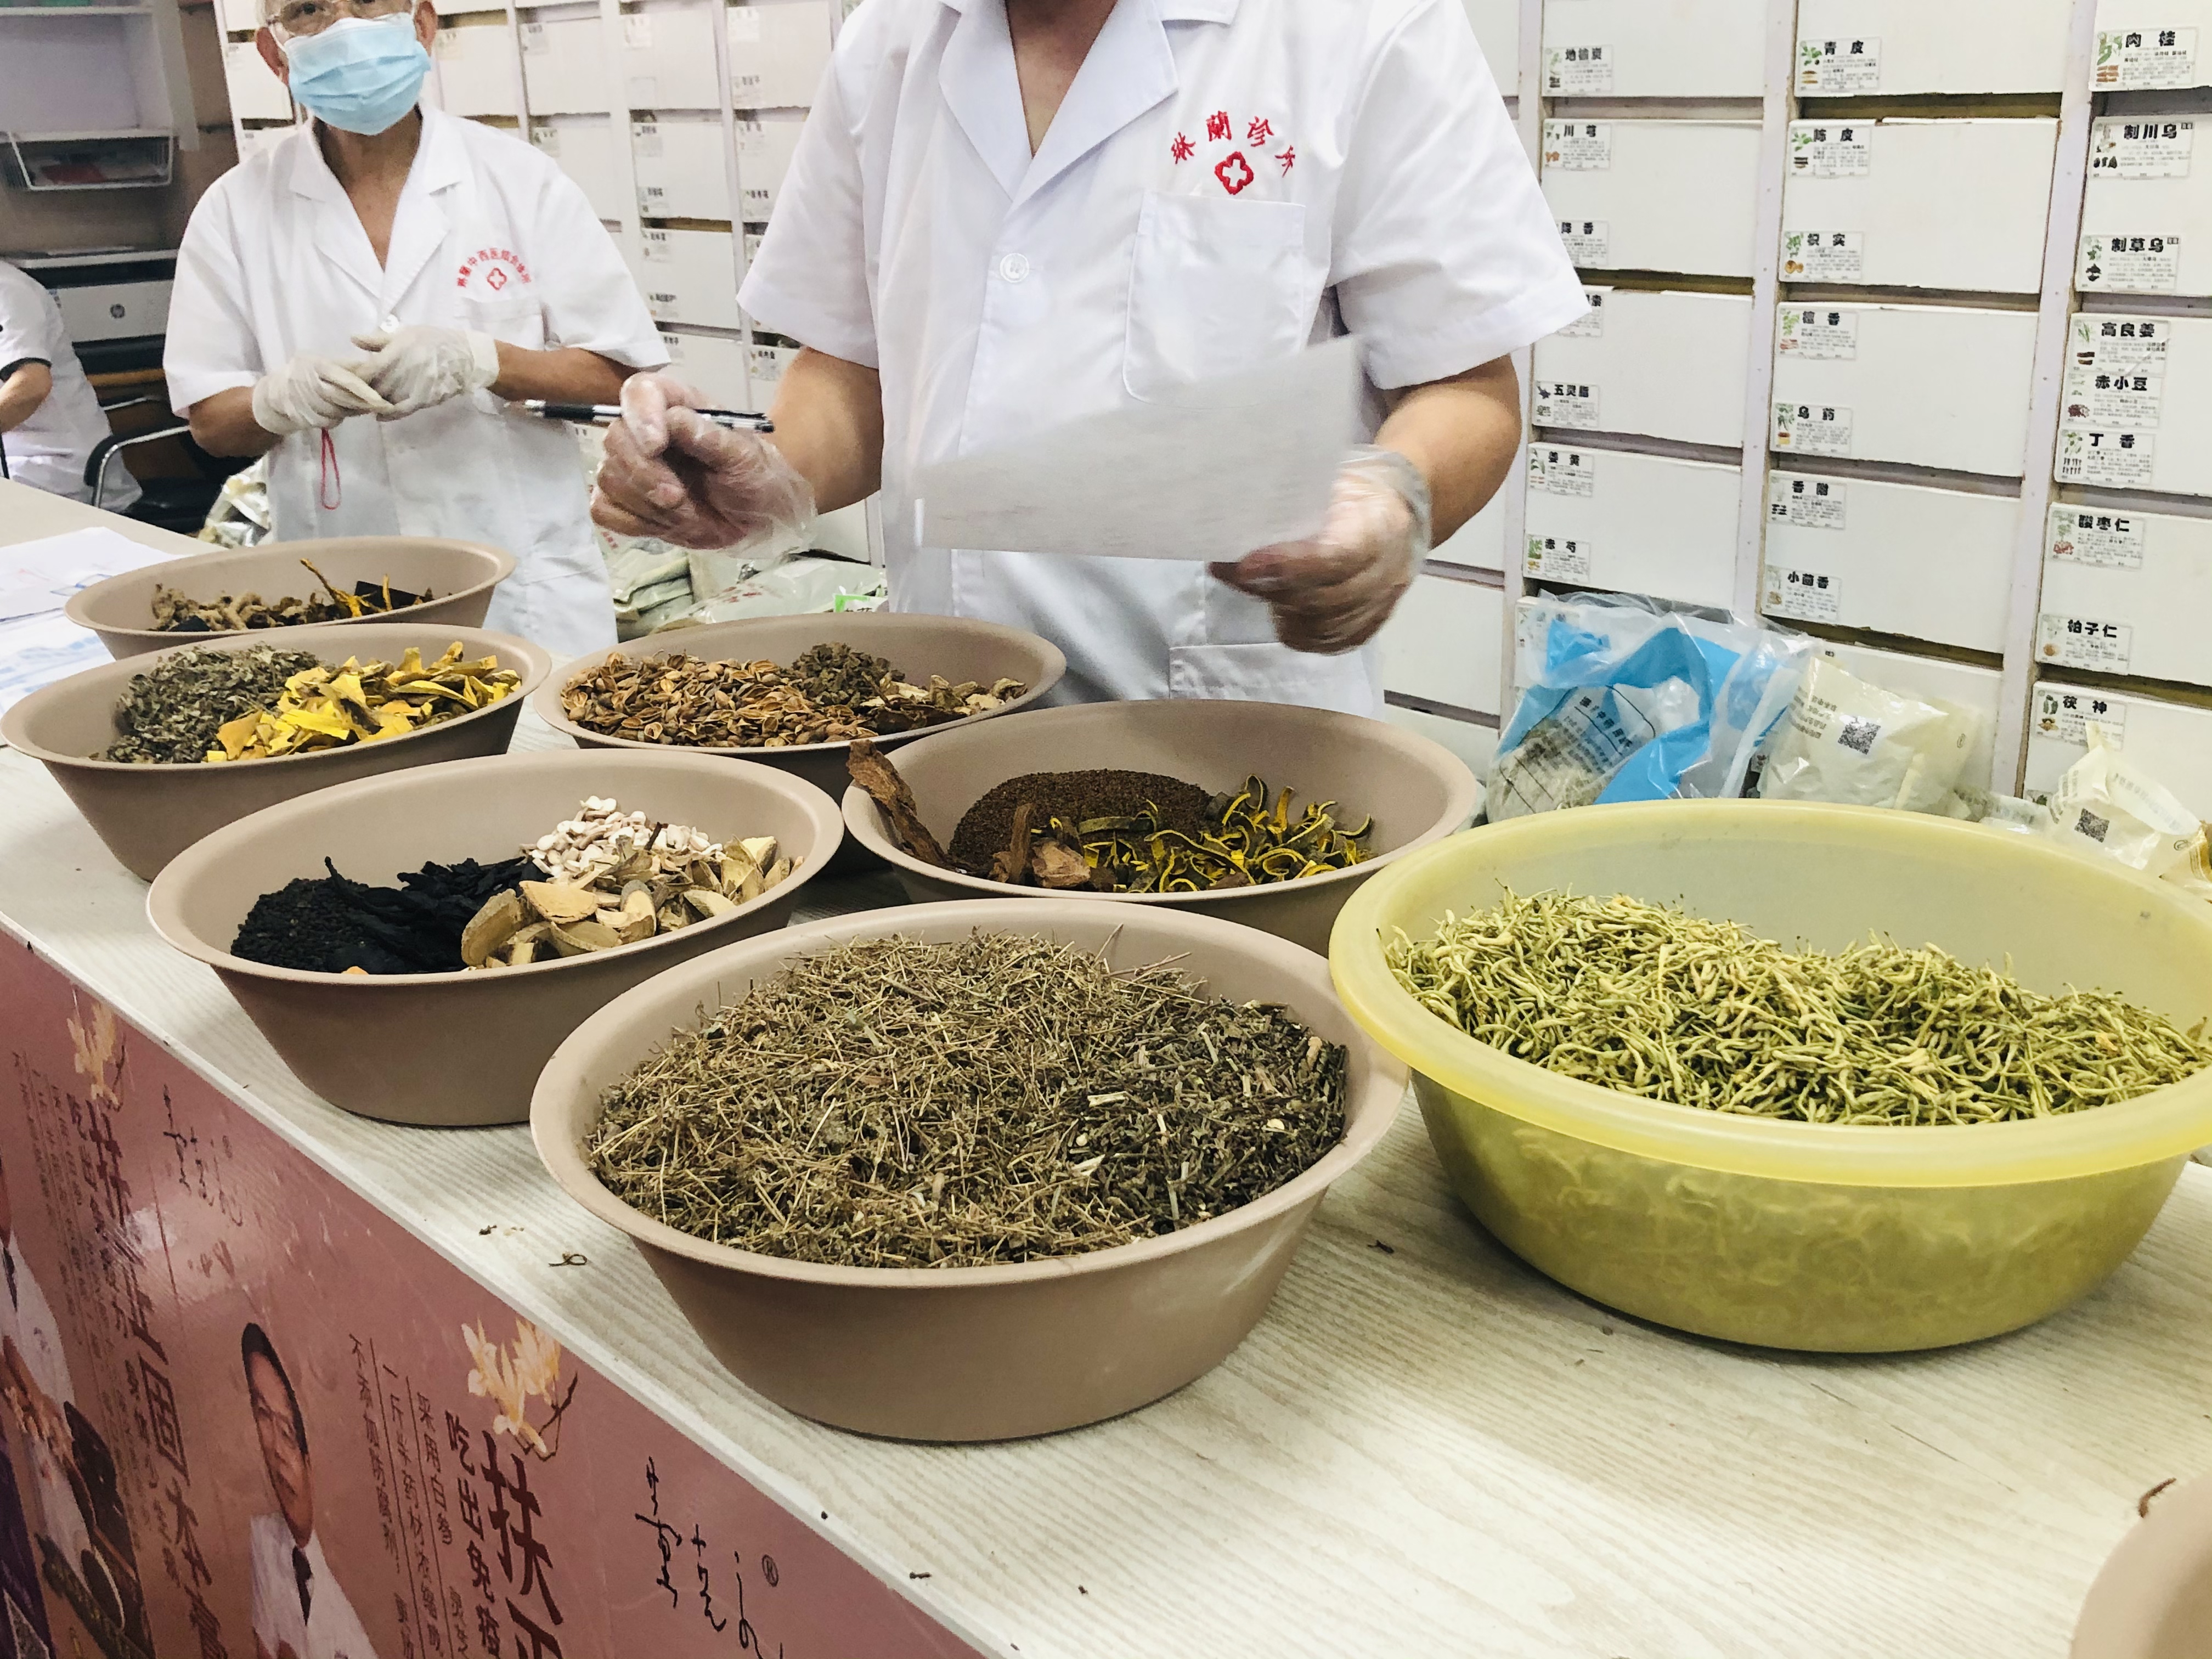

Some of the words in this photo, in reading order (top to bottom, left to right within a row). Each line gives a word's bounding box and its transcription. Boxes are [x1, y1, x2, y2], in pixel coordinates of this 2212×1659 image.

[2125, 31, 2175, 47] 肉桂
[1825, 40, 1864, 55] 青皮
[1564, 125, 1596, 137] 川芎
[1814, 128, 1853, 142] 陈皮
[2124, 124, 2177, 139] 制川乌
[1561, 222, 1593, 234] 降香
[1807, 233, 1845, 246] 枳实
[2112, 238, 2164, 252] 制草乌
[2101, 322, 2154, 337] 高良姜
[2095, 375, 2147, 391] 赤小豆
[1554, 385, 1589, 397] 五灵脂
[1798, 406, 1835, 421] 乌药
[2089, 433, 2135, 448] 丁香
[1549, 452, 1579, 466] 姜黄
[2079, 515, 2129, 532] 酸枣仁
[1545, 538, 1576, 553] 赤芍
[1788, 571, 1829, 589] 小茴香
[2068, 619, 2117, 637] 柏子仁
[2063, 695, 2107, 714] 茯神
[417, 1391, 453, 1545] 采用白参
[445, 1409, 501, 1659] 吃出免疫
